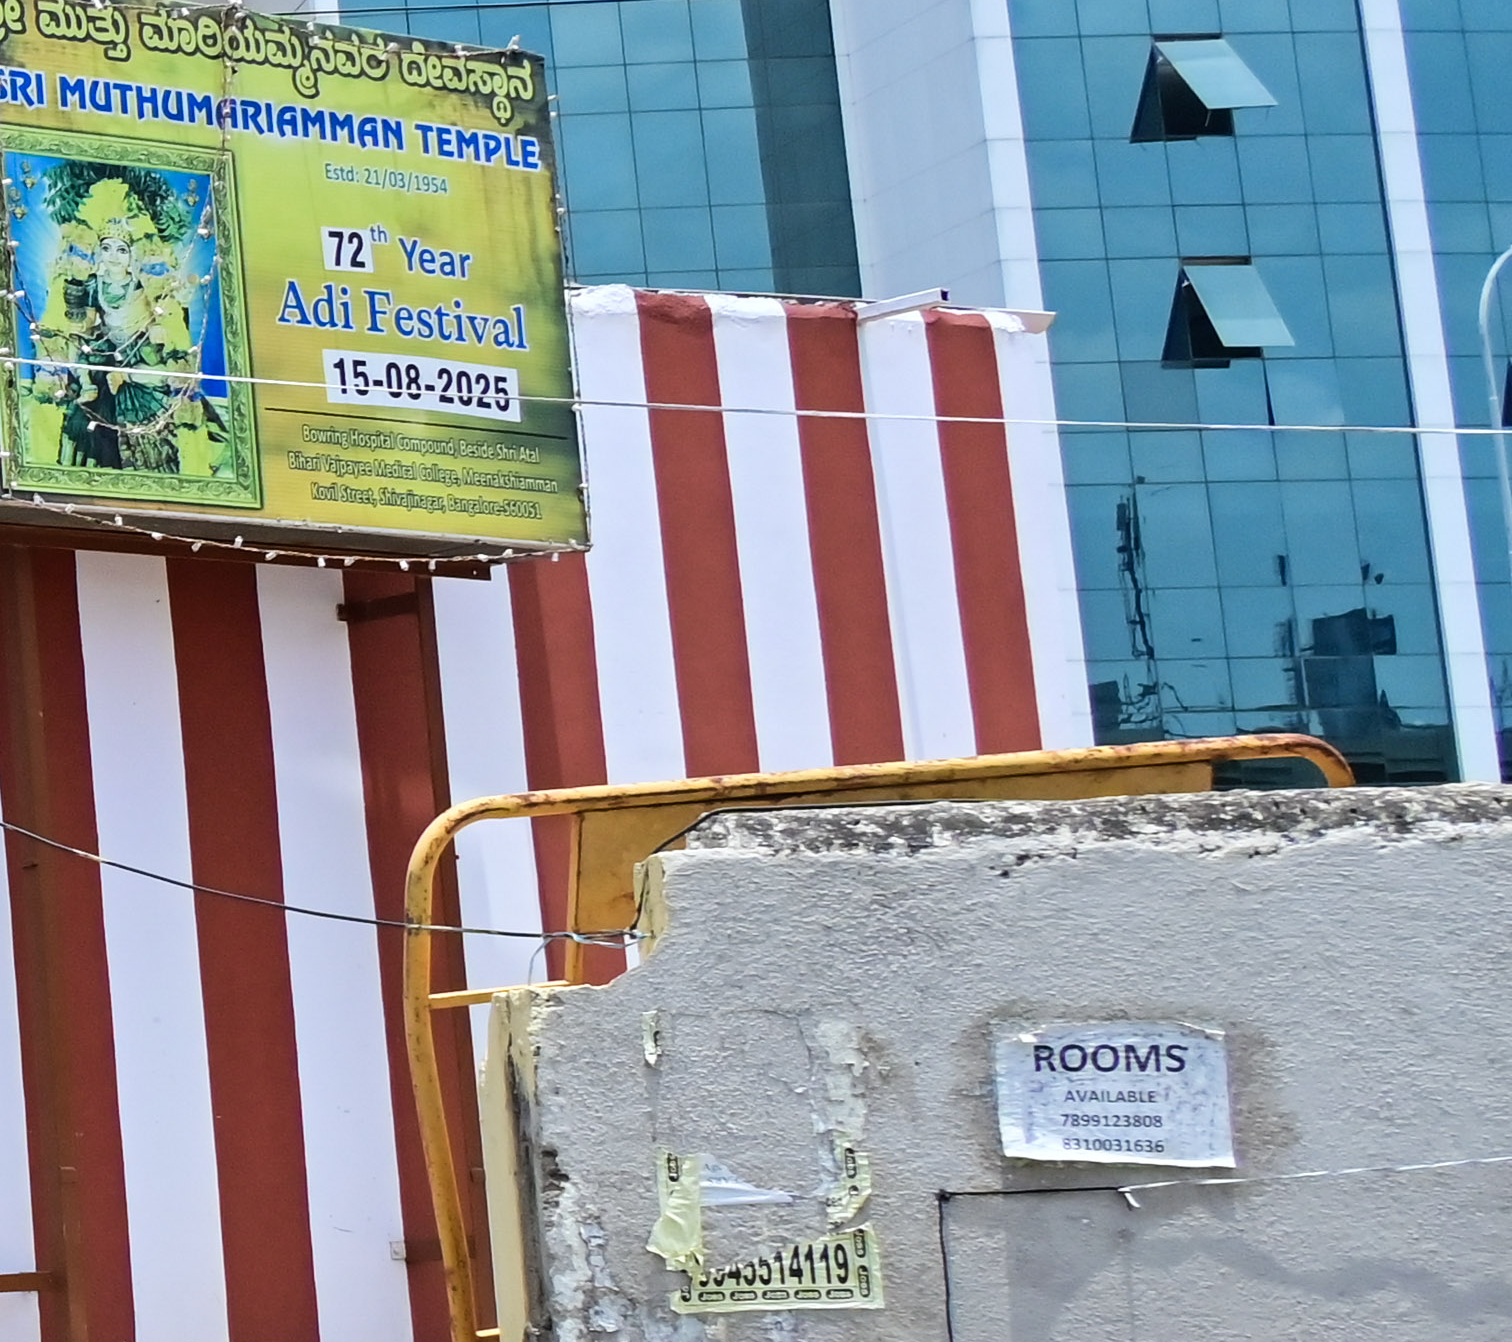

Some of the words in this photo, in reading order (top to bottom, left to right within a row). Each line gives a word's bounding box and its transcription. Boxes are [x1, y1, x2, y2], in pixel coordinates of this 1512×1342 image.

[401, 41, 533, 124] ದೇವಸ್ಥಾನ
[59, 75, 404, 150] MUTHUMARIAMMAN
[414, 122, 541, 170] TEMPLE
[325, 163, 360, 184] Estd:
[364, 167, 449, 194] 21/03/1954
[398, 237, 472, 278] Year
[278, 280, 354, 330] Adi
[364, 289, 528, 349] Festival
[333, 357, 510, 412] 15-08-2025
[302, 424, 348, 448] Bowring
[350, 429, 395, 451] Hospital
[397, 435, 458, 459] Compound,
[459, 441, 494, 460] Beside
[496, 444, 516, 461] Shri
[519, 447, 540, 464] Atal
[288, 451, 321, 472] Bihari
[323, 455, 372, 479] Vajpayee
[374, 460, 417, 481] Medical
[419, 463, 462, 487] College,
[464, 467, 558, 493] Meenakshiamman
[311, 482, 339, 501] Kovil
[339, 484, 377, 507] Street,
[1033, 1043, 1189, 1073] ROOMS
[1064, 1089, 1158, 1103] AVAILABLE
[1061, 1114, 1163, 1128] 7899123808
